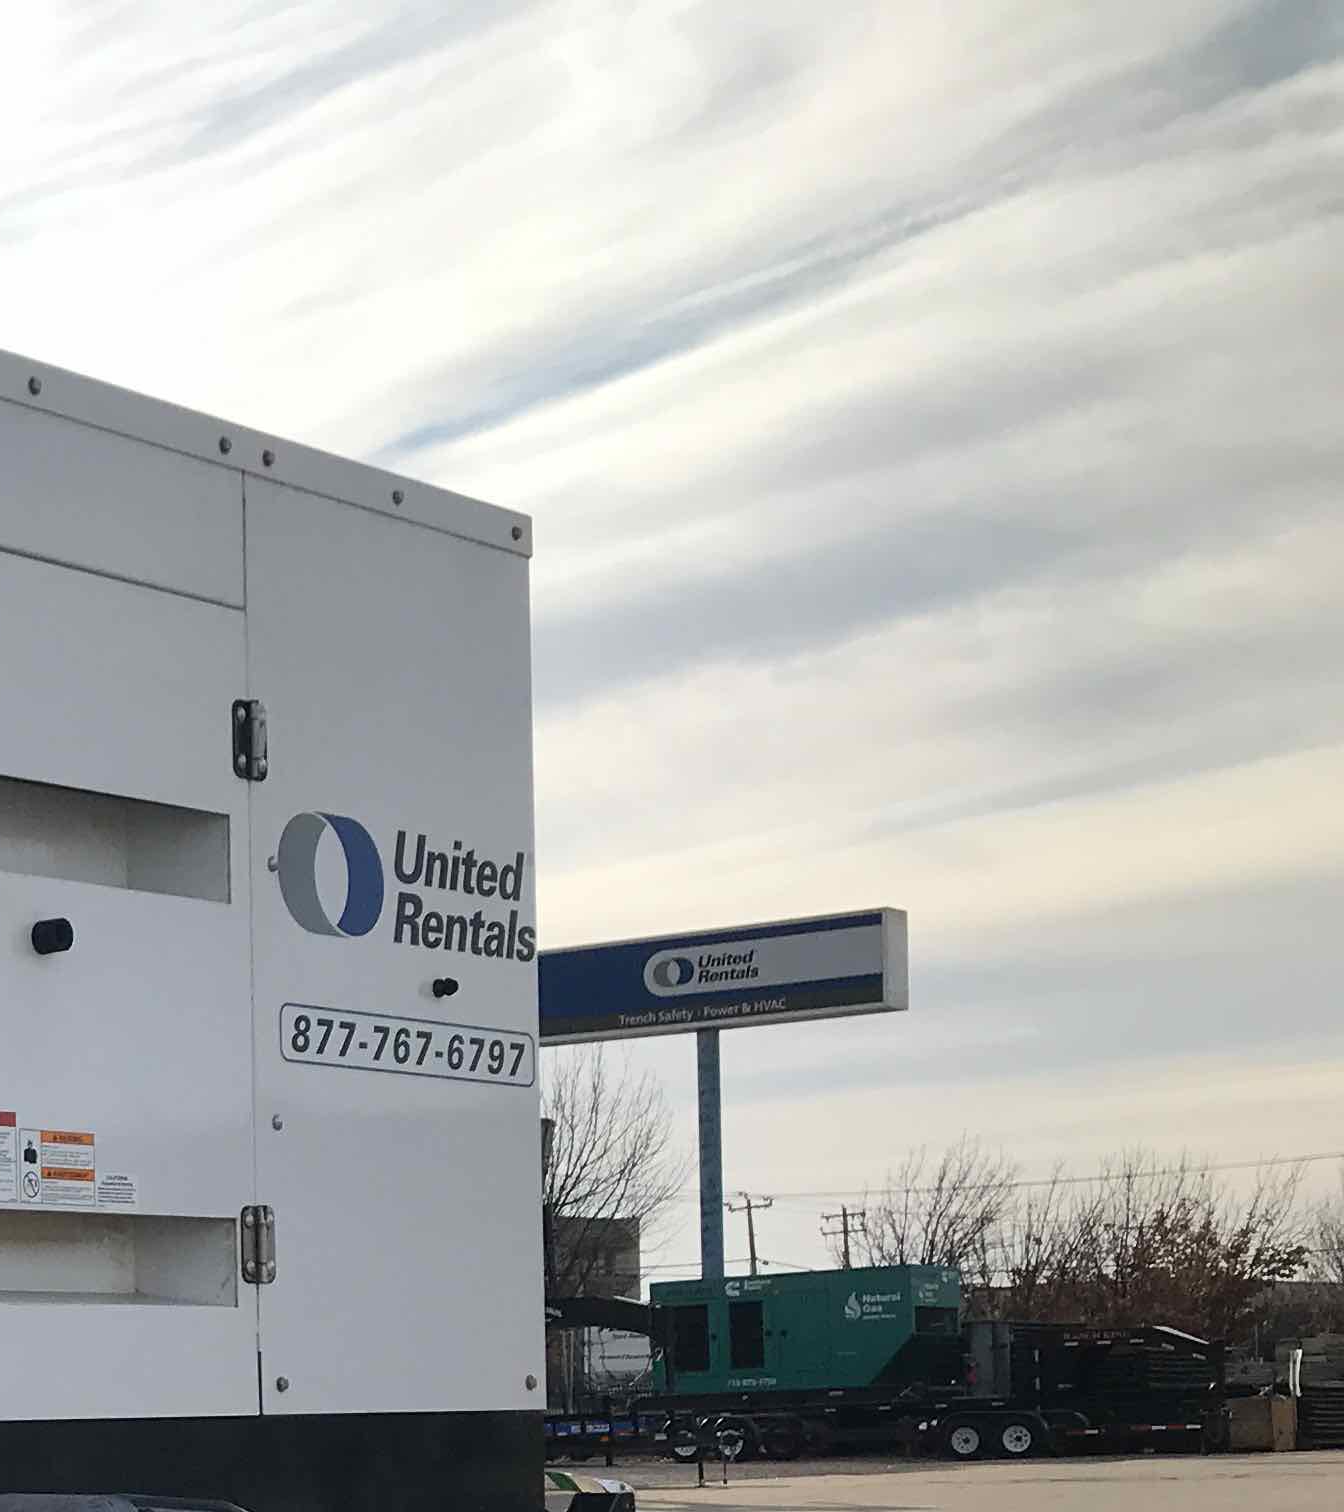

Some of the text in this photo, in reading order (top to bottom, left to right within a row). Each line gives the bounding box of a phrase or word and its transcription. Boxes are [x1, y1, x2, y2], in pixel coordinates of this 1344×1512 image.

[393, 830, 525, 901] United
[393, 891, 536, 962] Rentals
[698, 949, 755, 968] United
[697, 965, 759, 984] Rentals
[619, 1011, 656, 1025] Trench
[657, 1008, 694, 1023] Safety
[703, 1004, 739, 1017] Power
[753, 998, 787, 1012] HVAC
[291, 1014, 525, 1076] 877-767-6797
[862, 1292, 901, 1303] Natural
[862, 1303, 883, 1313] Gas
